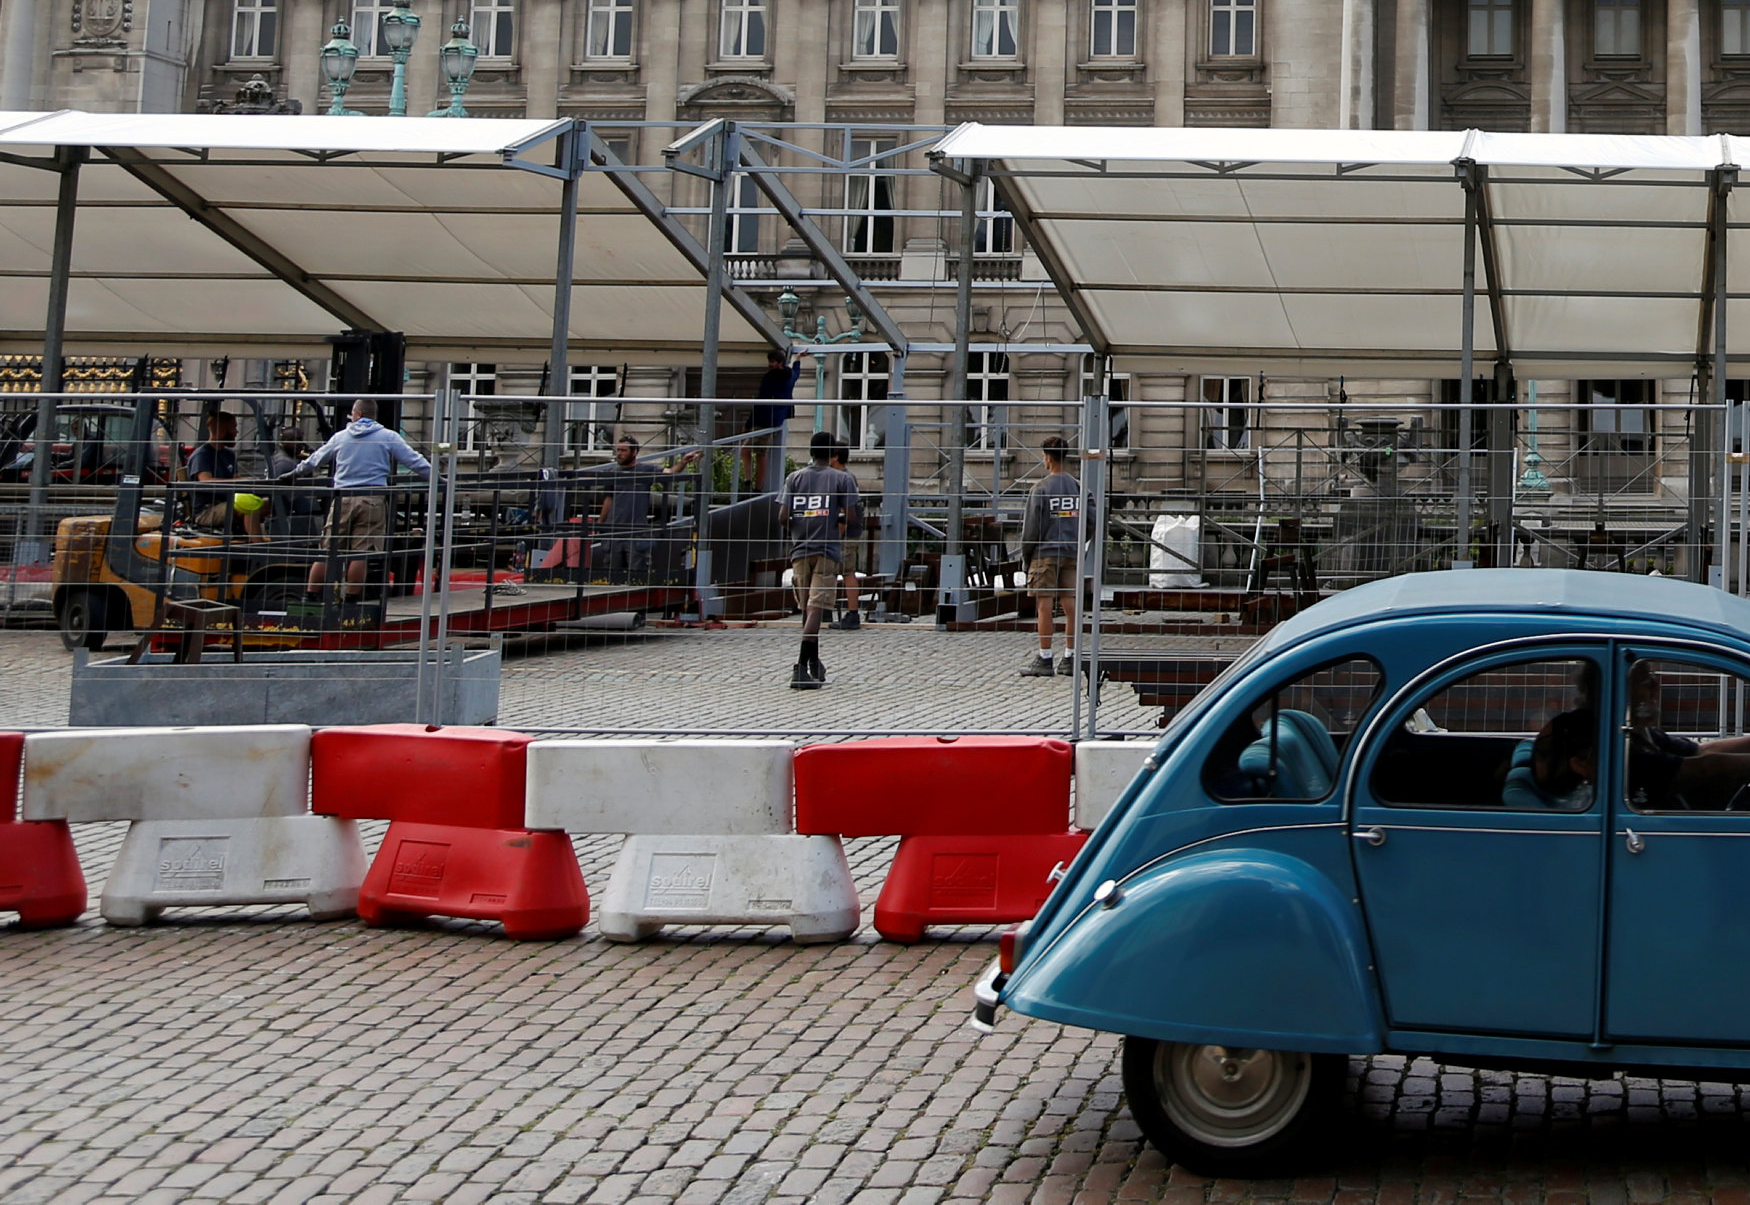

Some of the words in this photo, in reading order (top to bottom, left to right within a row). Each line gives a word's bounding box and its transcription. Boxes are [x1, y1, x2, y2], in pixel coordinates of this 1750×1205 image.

[793, 495, 830, 510] PBI
[1050, 497, 1079, 510] PBI
[650, 873, 713, 888] sodirel
